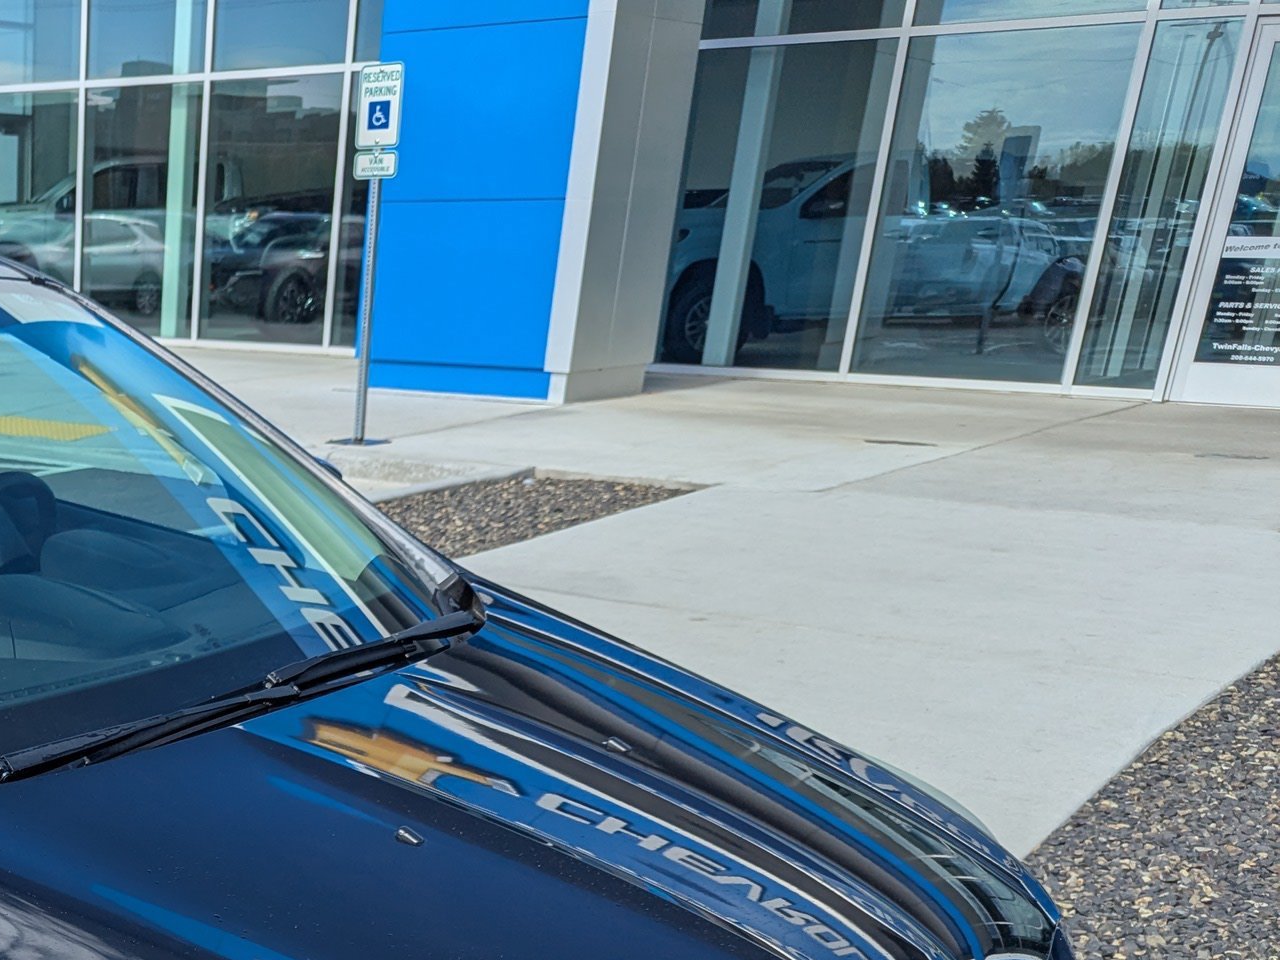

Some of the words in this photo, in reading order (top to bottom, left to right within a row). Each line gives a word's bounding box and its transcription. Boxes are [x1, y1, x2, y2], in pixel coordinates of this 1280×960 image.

[363, 70, 401, 83] RESERVED
[364, 85, 397, 98] PARKING
[368, 157, 385, 166] VAN
[1225, 243, 1271, 253] Welcome
[1218, 301, 1245, 309] PARTS
